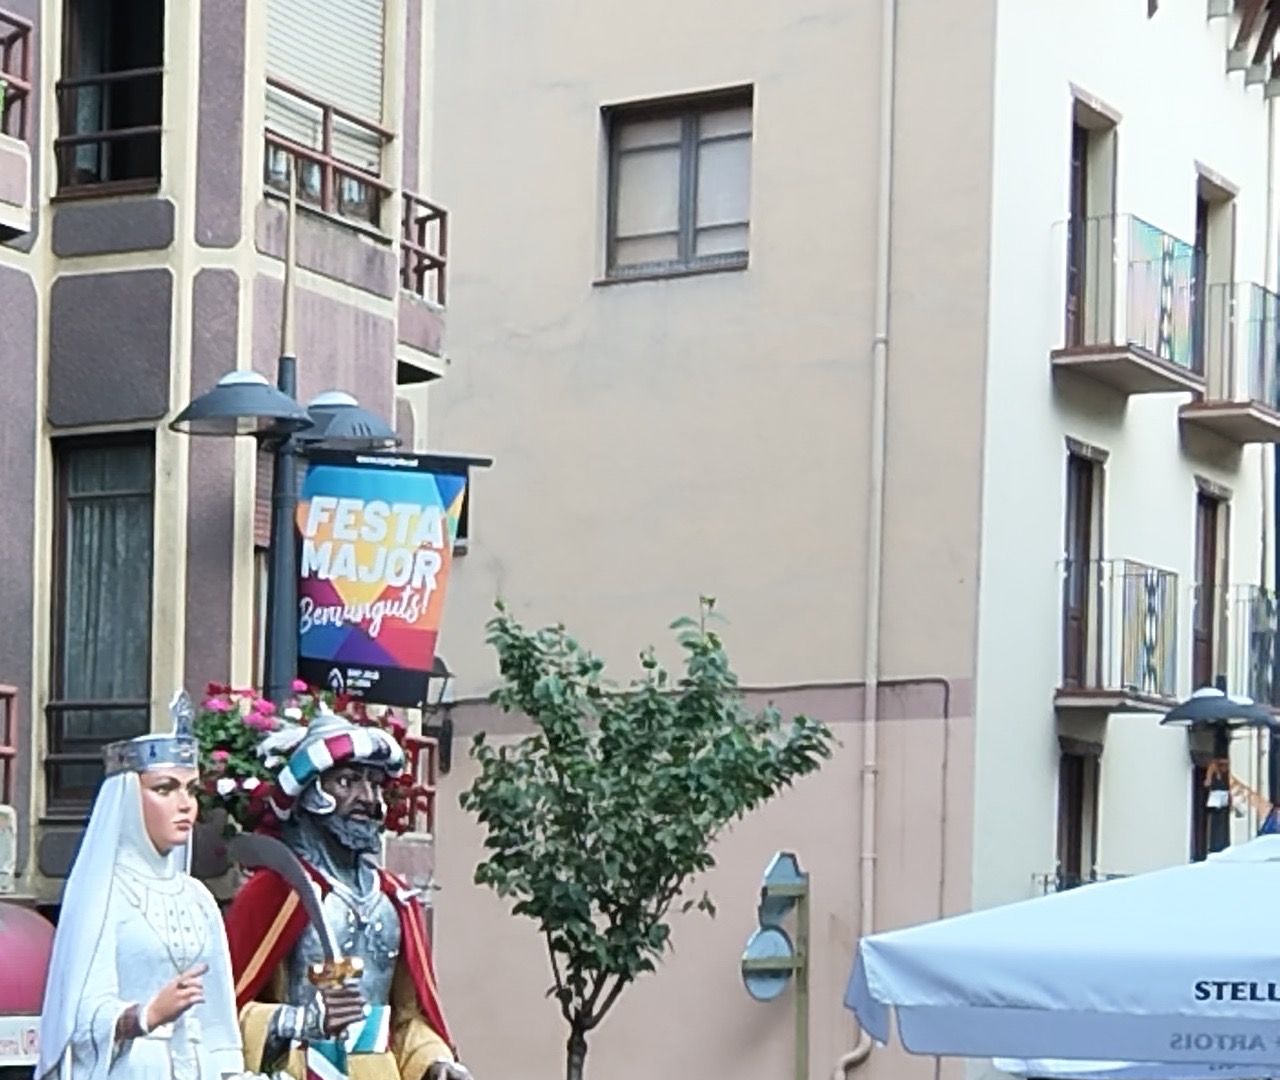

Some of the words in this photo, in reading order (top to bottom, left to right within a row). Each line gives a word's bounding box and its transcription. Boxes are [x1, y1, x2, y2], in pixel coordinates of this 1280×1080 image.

[306, 495, 445, 549] FESTA
[301, 538, 442, 591] MAJOR
[1194, 980, 1280, 1002] STELL
